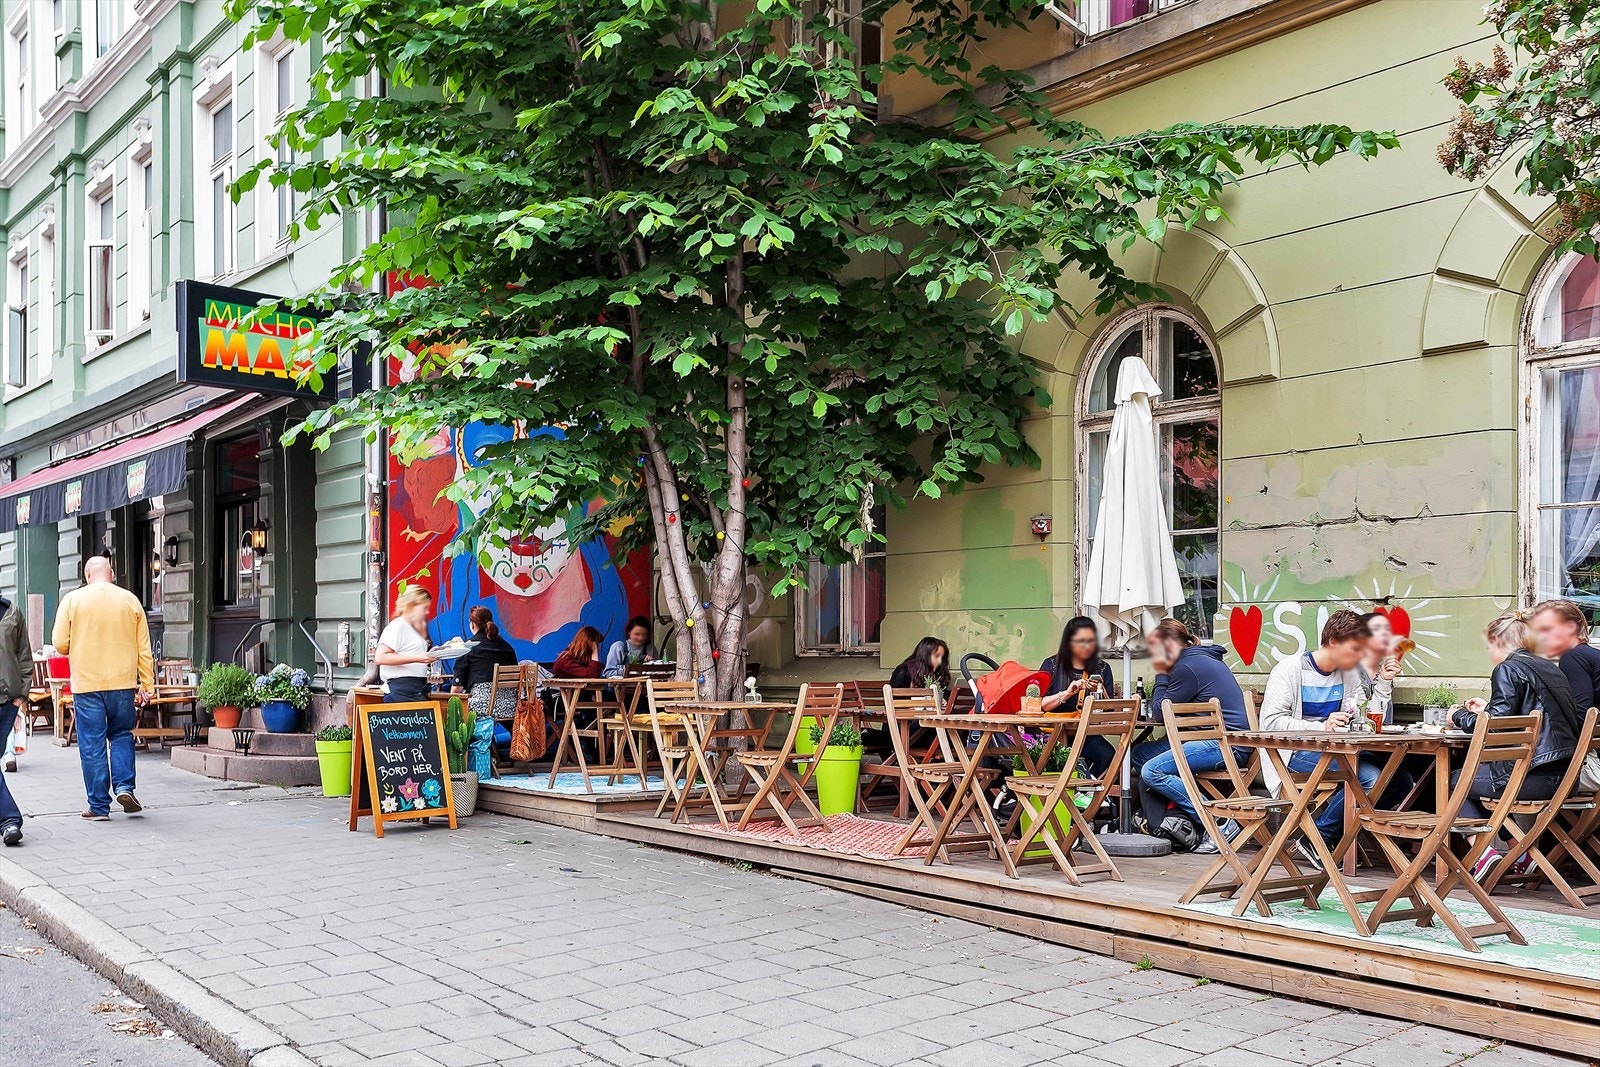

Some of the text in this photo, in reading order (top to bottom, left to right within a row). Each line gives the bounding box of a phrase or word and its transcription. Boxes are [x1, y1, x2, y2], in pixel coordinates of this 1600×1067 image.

[380, 744, 426, 764] VENT PÅ
[378, 764, 440, 781] BORD HER.
